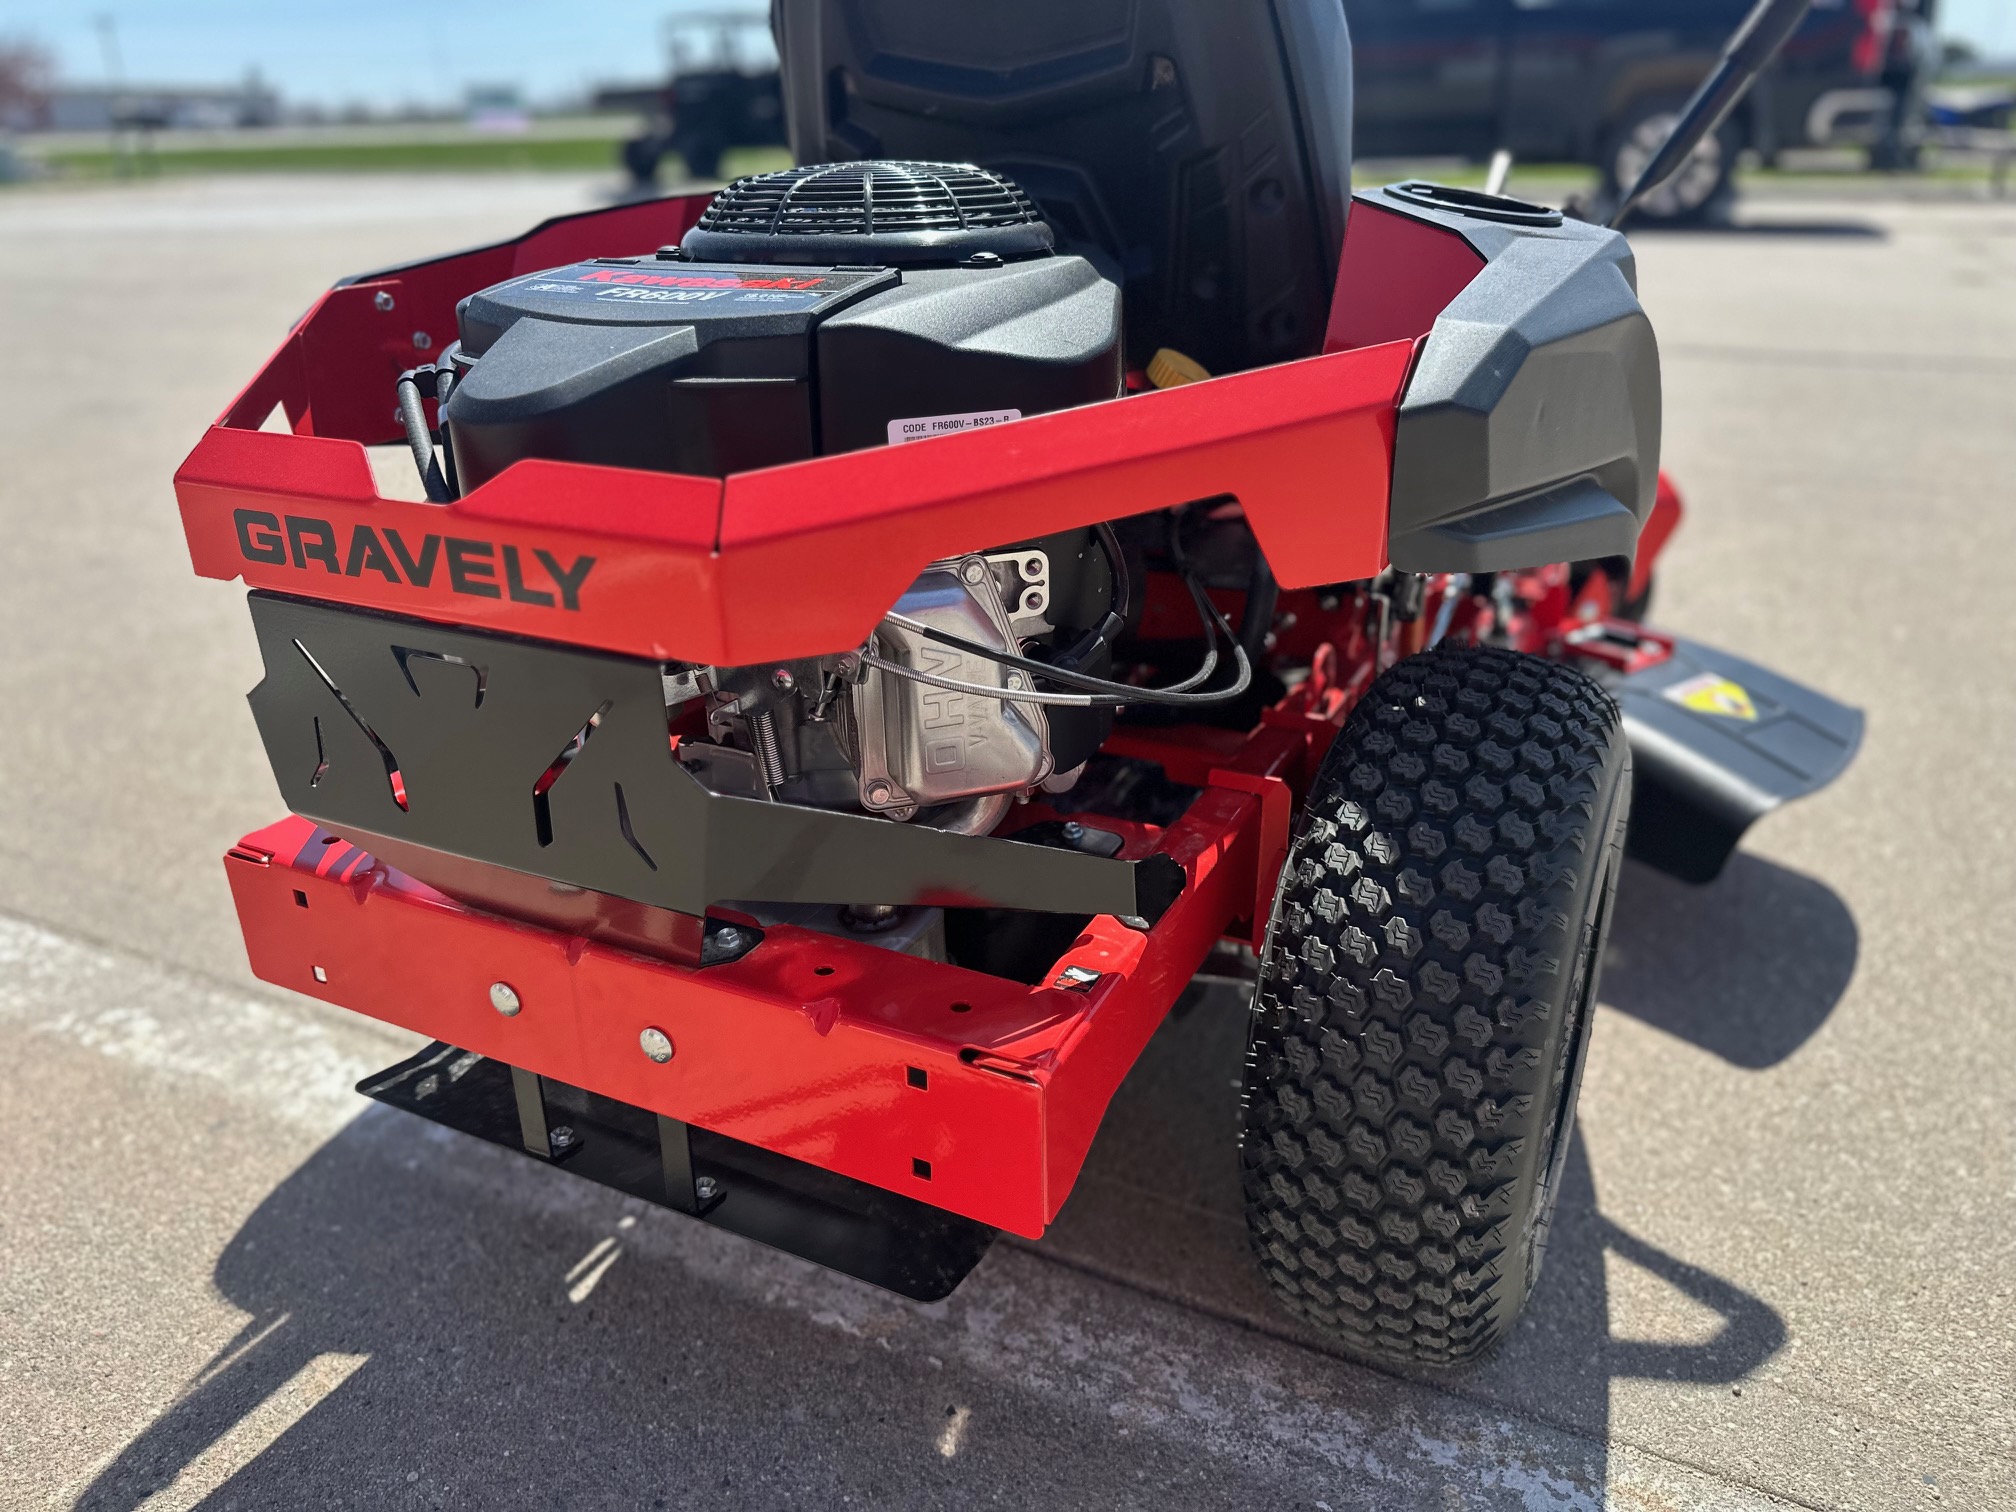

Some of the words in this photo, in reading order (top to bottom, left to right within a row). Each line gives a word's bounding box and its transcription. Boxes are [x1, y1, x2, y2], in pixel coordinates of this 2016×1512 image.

[578, 270, 826, 290] Kawasaki
[594, 286, 733, 301] FR600V
[902, 422, 927, 434] CODE
[233, 508, 598, 611] GRAVELY
